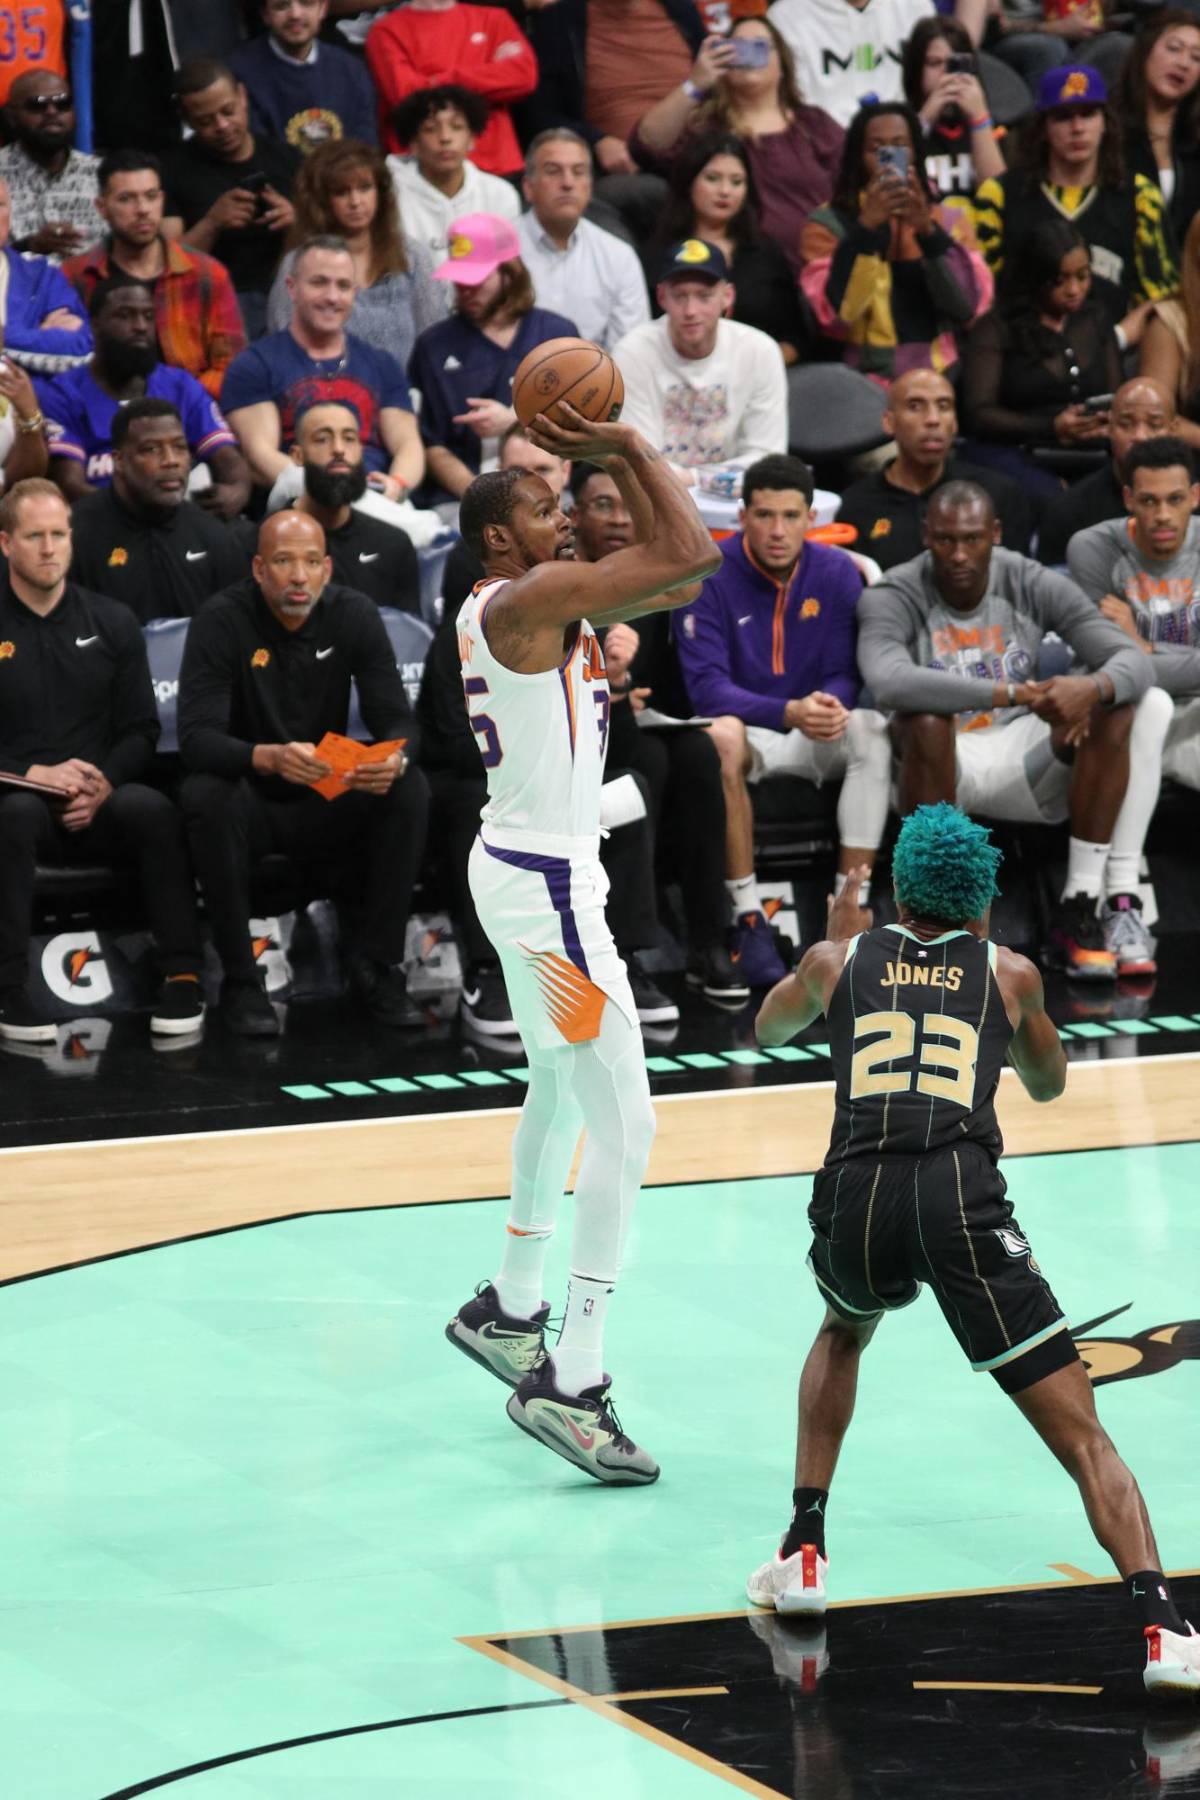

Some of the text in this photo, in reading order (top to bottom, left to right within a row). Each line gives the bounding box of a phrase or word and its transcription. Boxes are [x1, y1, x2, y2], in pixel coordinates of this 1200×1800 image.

[0, 6, 46, 62] 35
[464, 676, 503, 768] 5
[592, 689, 610, 761] 3
[41, 930, 114, 1005] G
[880, 961, 964, 991] JONES
[850, 1011, 980, 1112] 23
